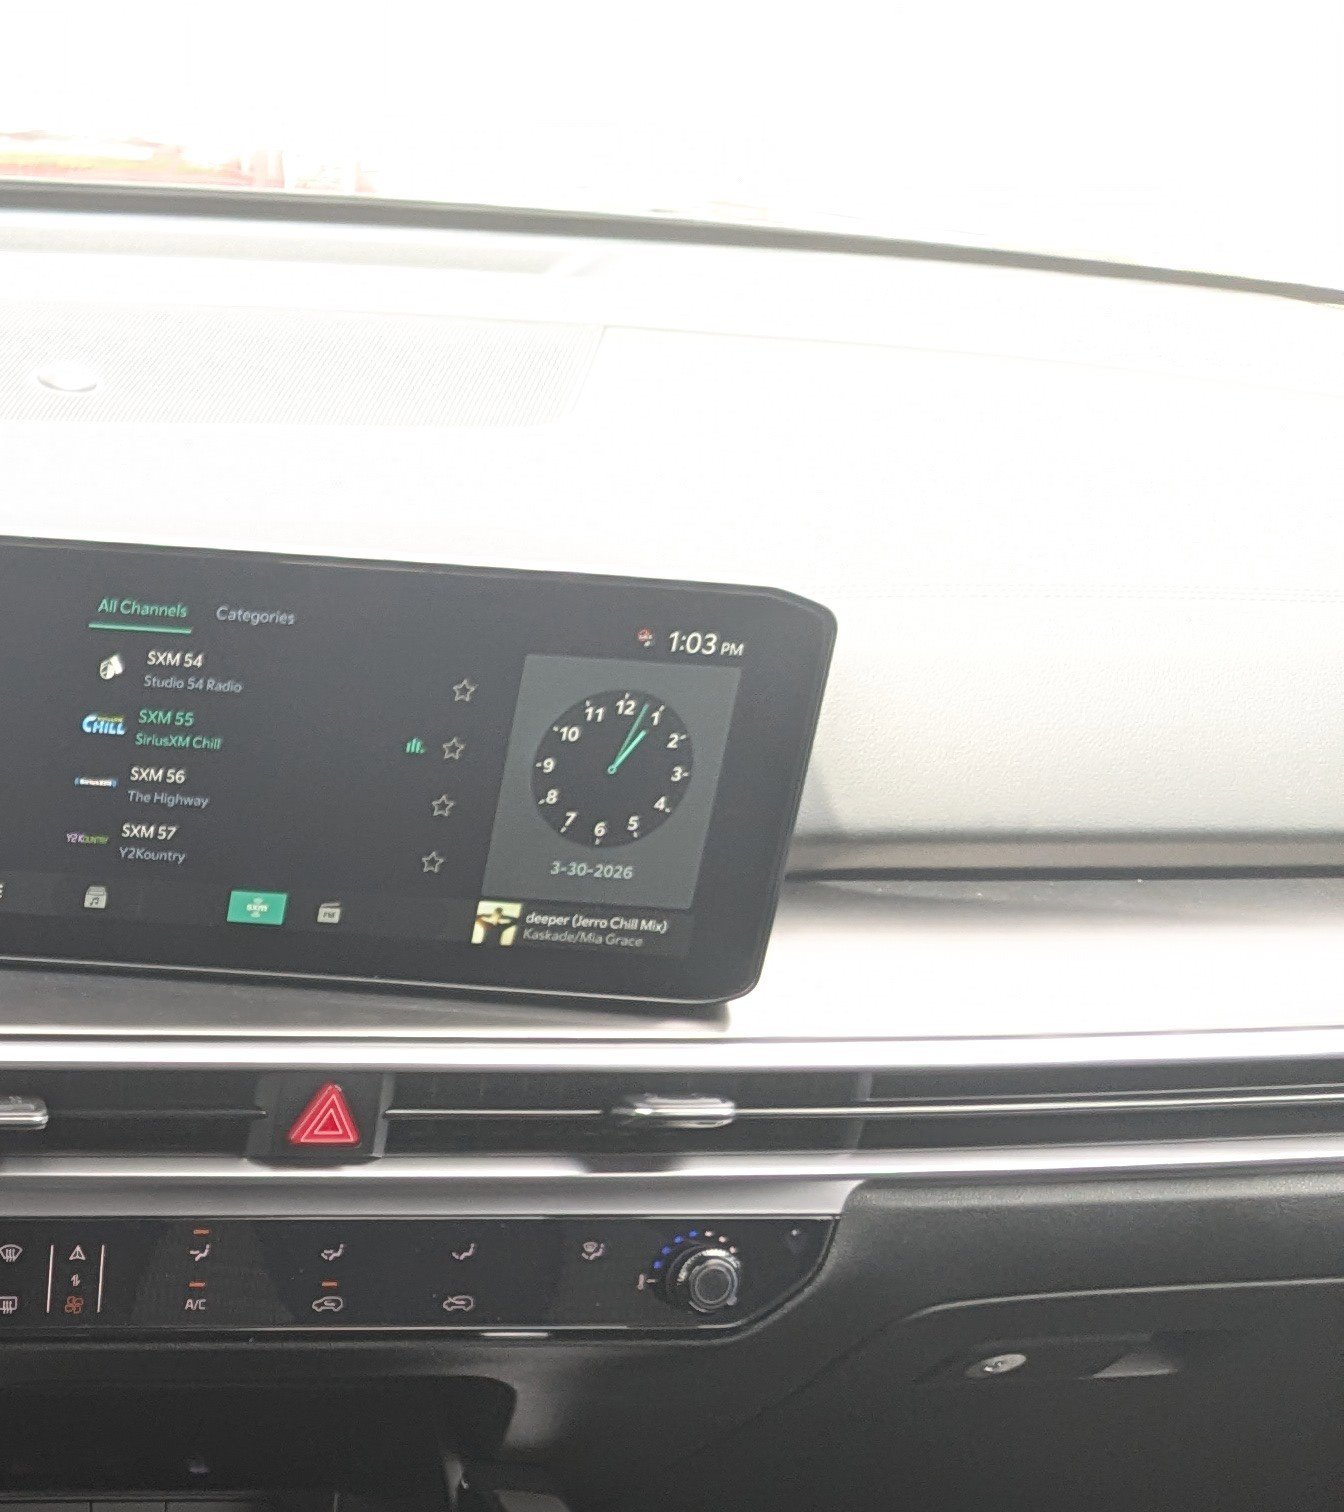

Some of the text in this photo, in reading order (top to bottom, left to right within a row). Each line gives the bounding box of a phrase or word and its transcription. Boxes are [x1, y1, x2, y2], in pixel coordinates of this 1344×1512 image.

[97, 599, 188, 618] All Channels
[216, 605, 296, 625] Categories
[668, 630, 745, 656] 1:03 PM
[146, 650, 205, 668] SXM 54
[143, 674, 244, 694] Studio 54 Radio
[585, 706, 605, 723] 11
[615, 699, 637, 717] 12
[138, 708, 173, 725] SXM
[174, 711, 195, 728] 55
[135, 731, 222, 750] SiriusXM Chill
[559, 726, 580, 743] 10
[666, 732, 680, 750] 2
[542, 757, 556, 774] 9
[670, 766, 683, 782] 3
[130, 766, 164, 783] SXM
[166, 768, 187, 785] 56
[128, 789, 210, 810] The Highway
[545, 789, 559, 805] 8
[653, 795, 667, 811] 4
[564, 810, 579, 827] 7
[626, 815, 640, 831] 5
[121, 823, 178, 841] SXM 57
[593, 821, 607, 837] 6
[119, 846, 186, 866] Y2Kountry
[549, 860, 635, 881] 3-30-2026
[525, 911, 570, 927] deeper
[609, 916, 639, 931] Chill
[605, 933, 644, 947] Grace
[184, 1298, 207, 1311] A/C
